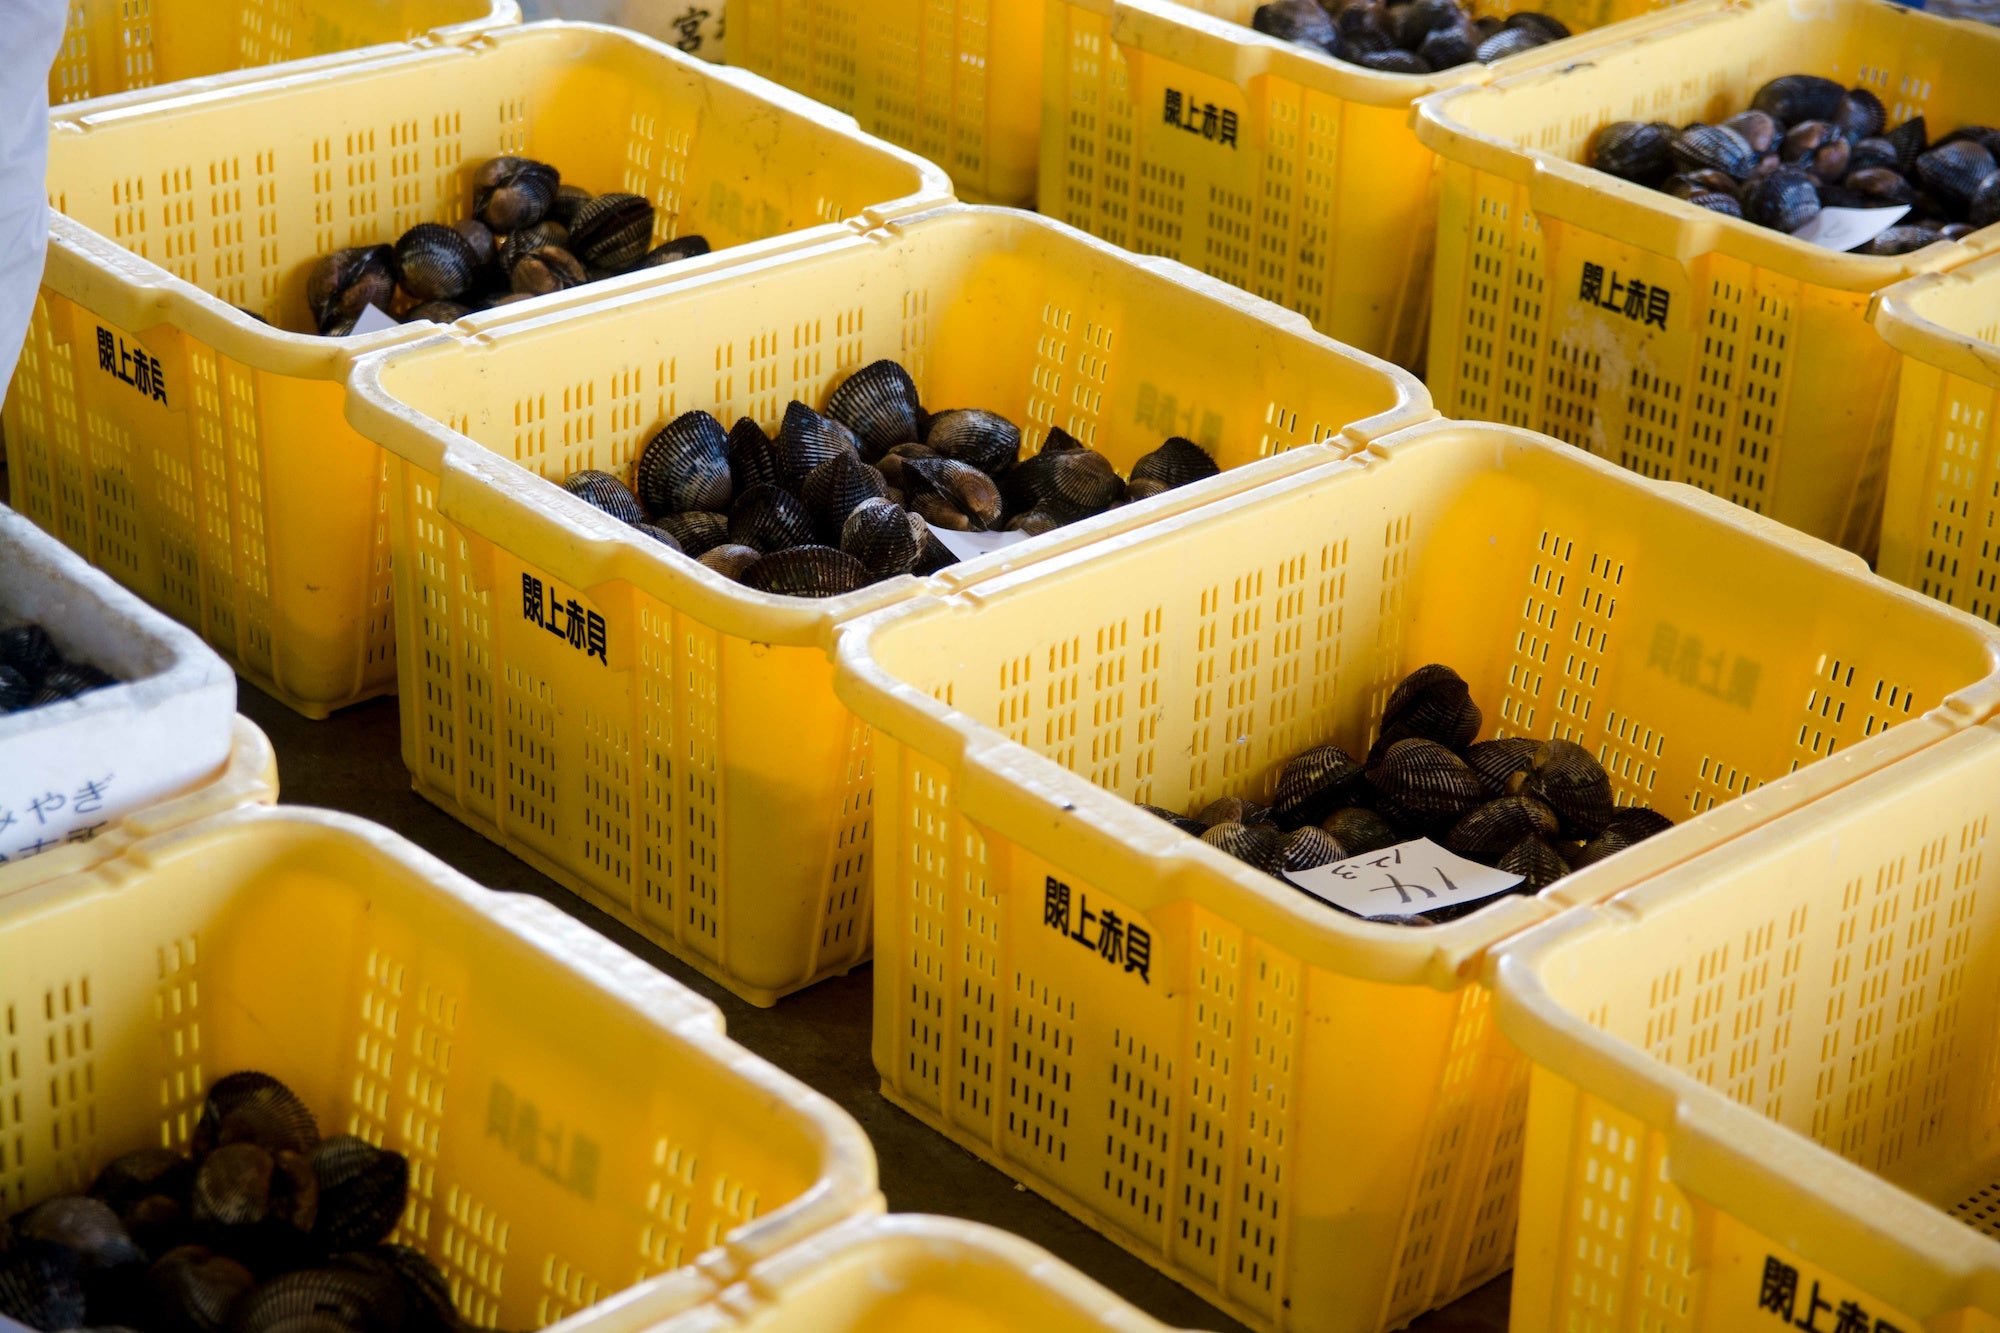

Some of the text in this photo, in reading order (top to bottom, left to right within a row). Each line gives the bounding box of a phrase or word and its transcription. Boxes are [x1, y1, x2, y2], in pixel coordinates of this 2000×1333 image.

[671, 5, 725, 53] 宮
[522, 572, 608, 667] 閖上赤貝
[1359, 871, 1449, 909] 14
[1044, 875, 1151, 984] 閖上赤貝
[1758, 1255, 1905, 1333] 閖上赤
